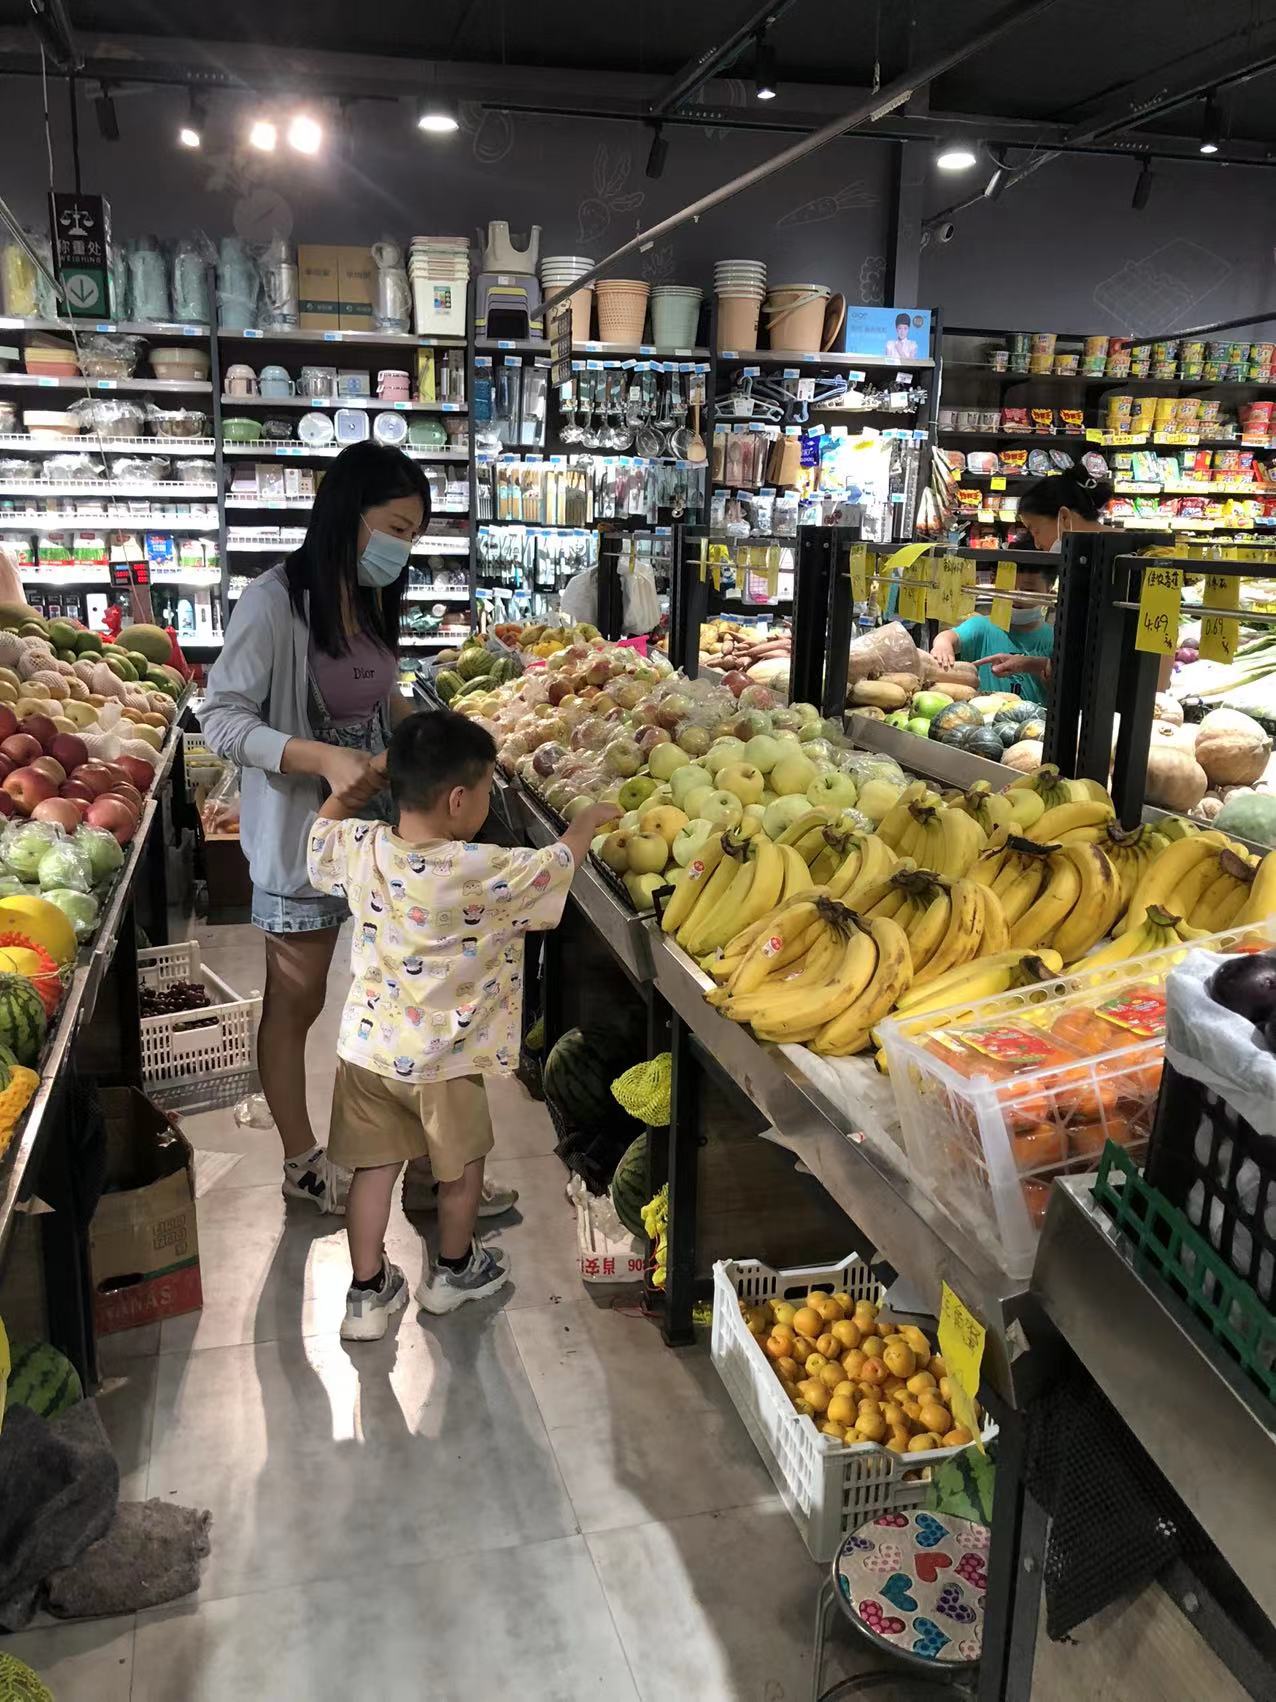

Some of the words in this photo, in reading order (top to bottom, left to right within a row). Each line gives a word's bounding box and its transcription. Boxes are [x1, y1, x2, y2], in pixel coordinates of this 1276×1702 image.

[57, 239, 102, 256] 称重处
[352, 667, 375, 680] Dior
